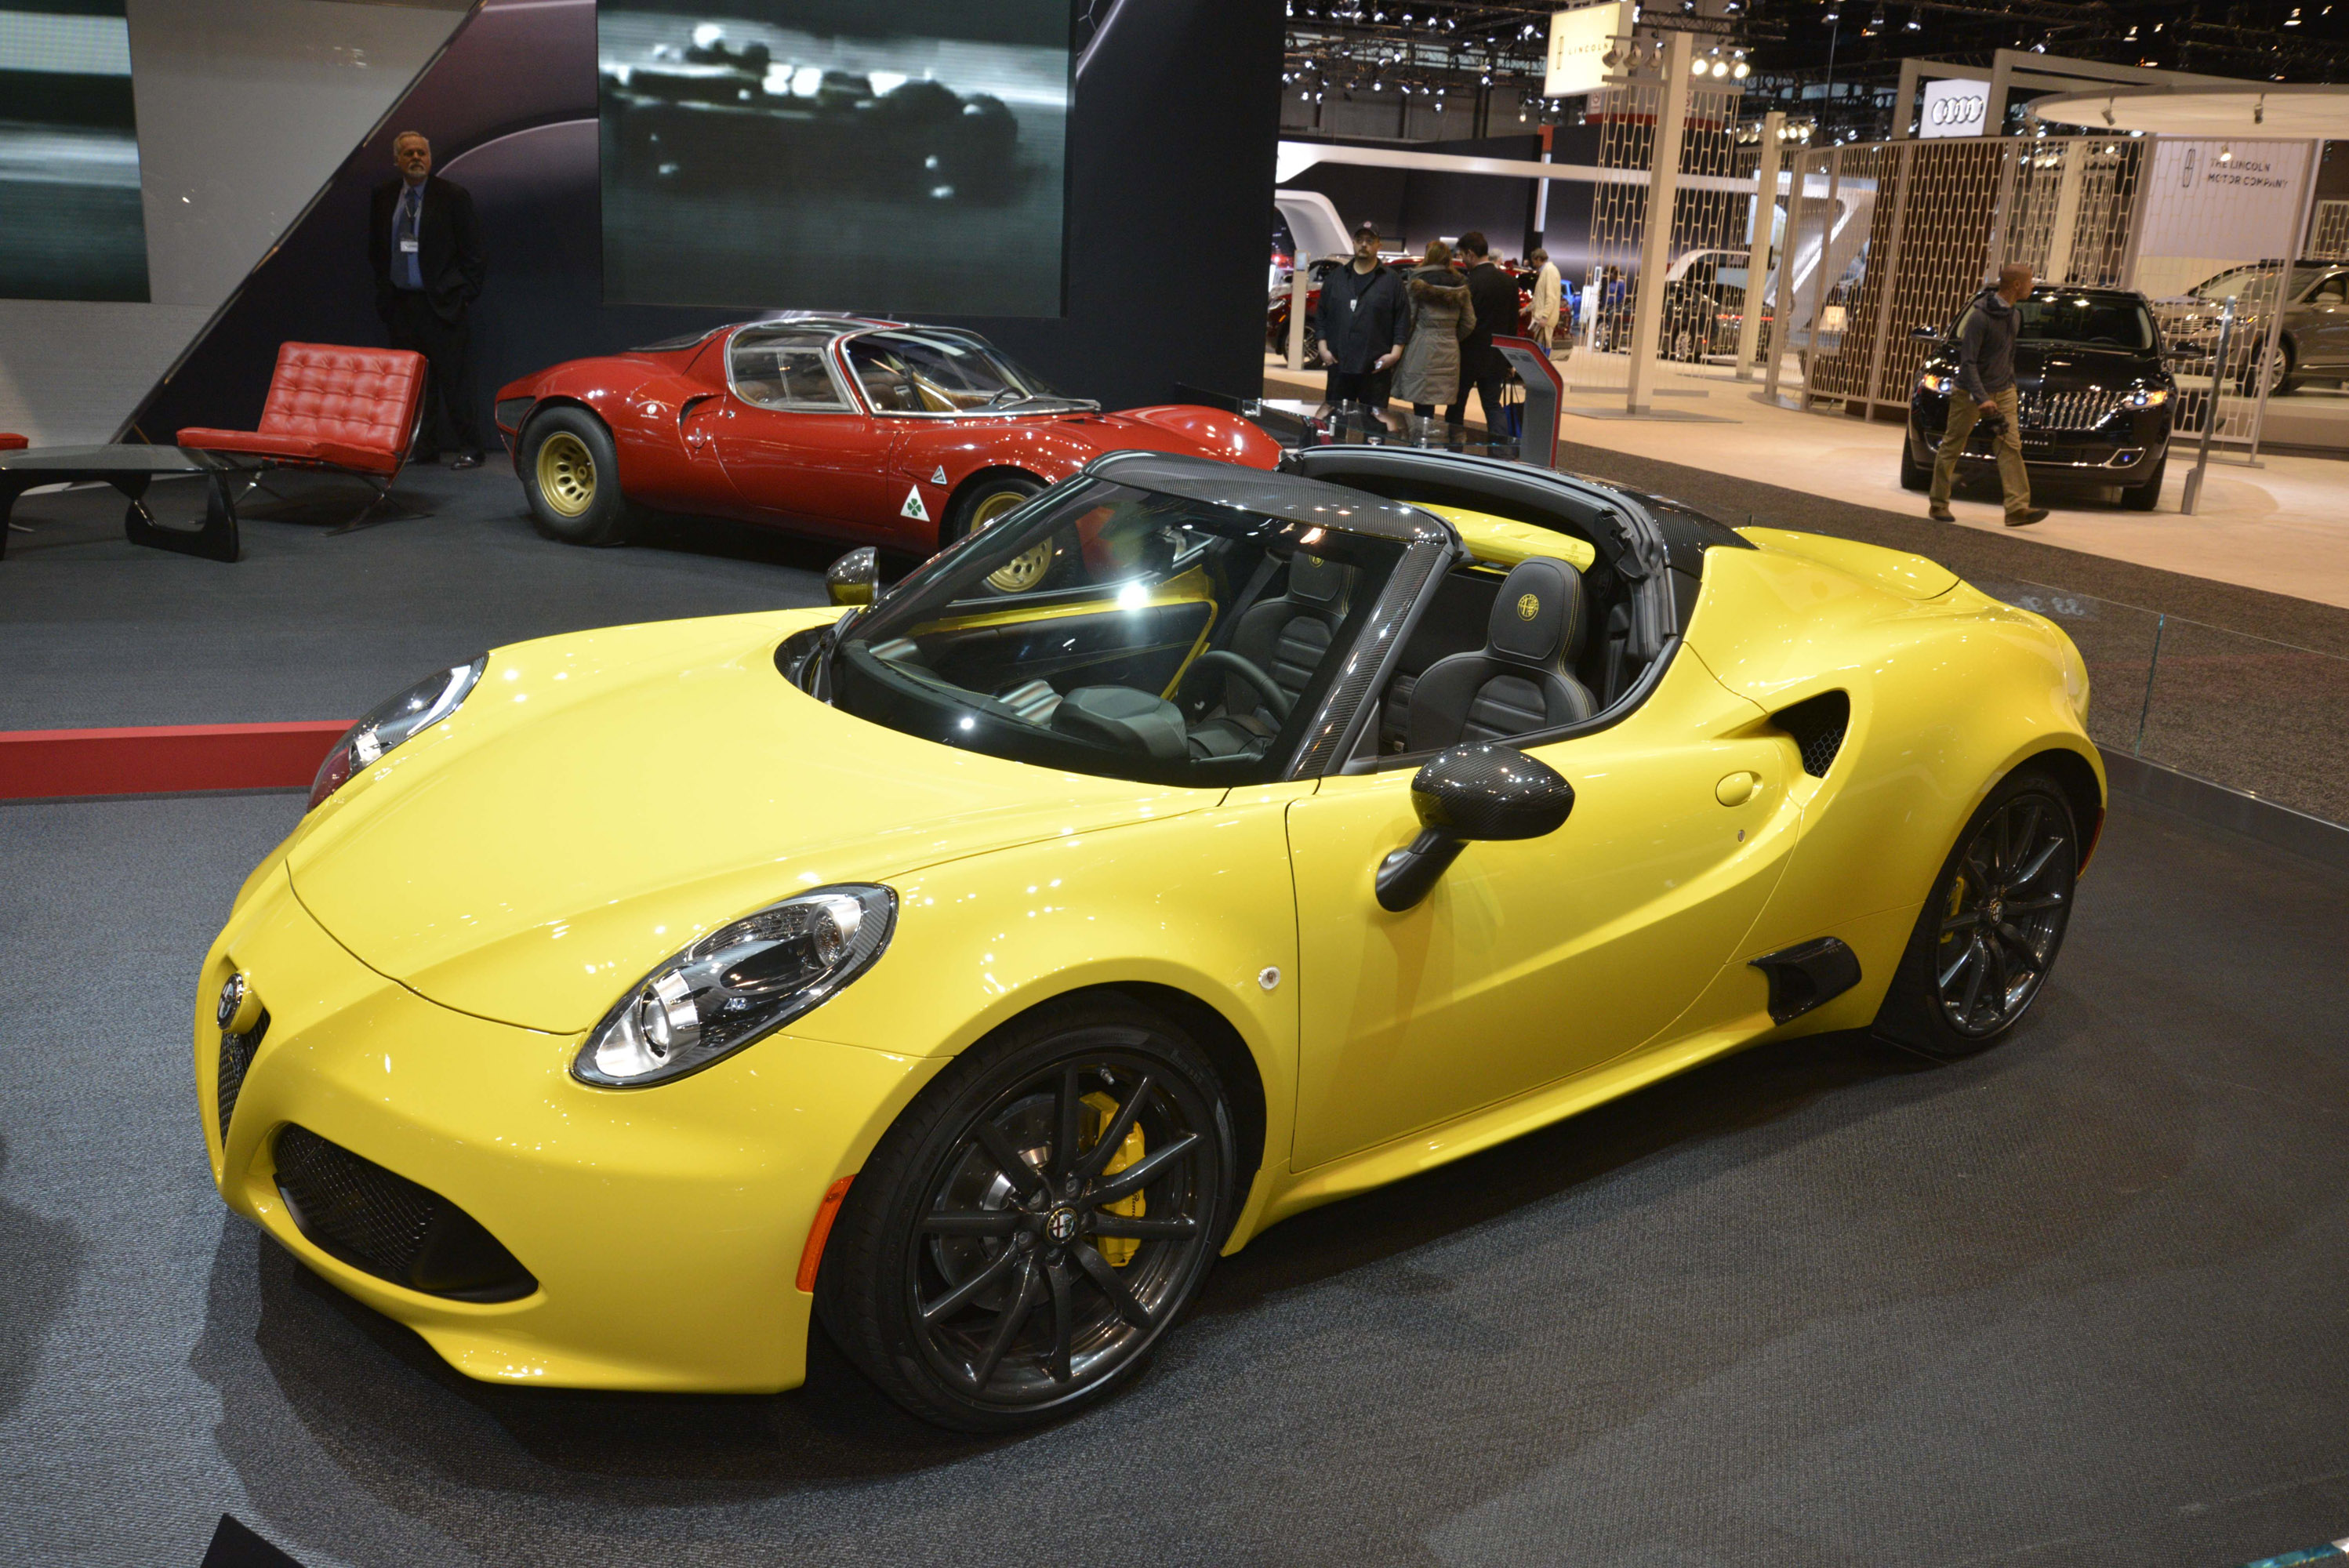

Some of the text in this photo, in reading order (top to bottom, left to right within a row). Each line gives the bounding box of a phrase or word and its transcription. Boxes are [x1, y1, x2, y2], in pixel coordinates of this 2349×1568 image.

[1569, 42, 1609, 56] LINCOLN
[2210, 158, 2271, 172] THE LINCOLN
[2207, 173, 2288, 188] MOTOR COMPANY
